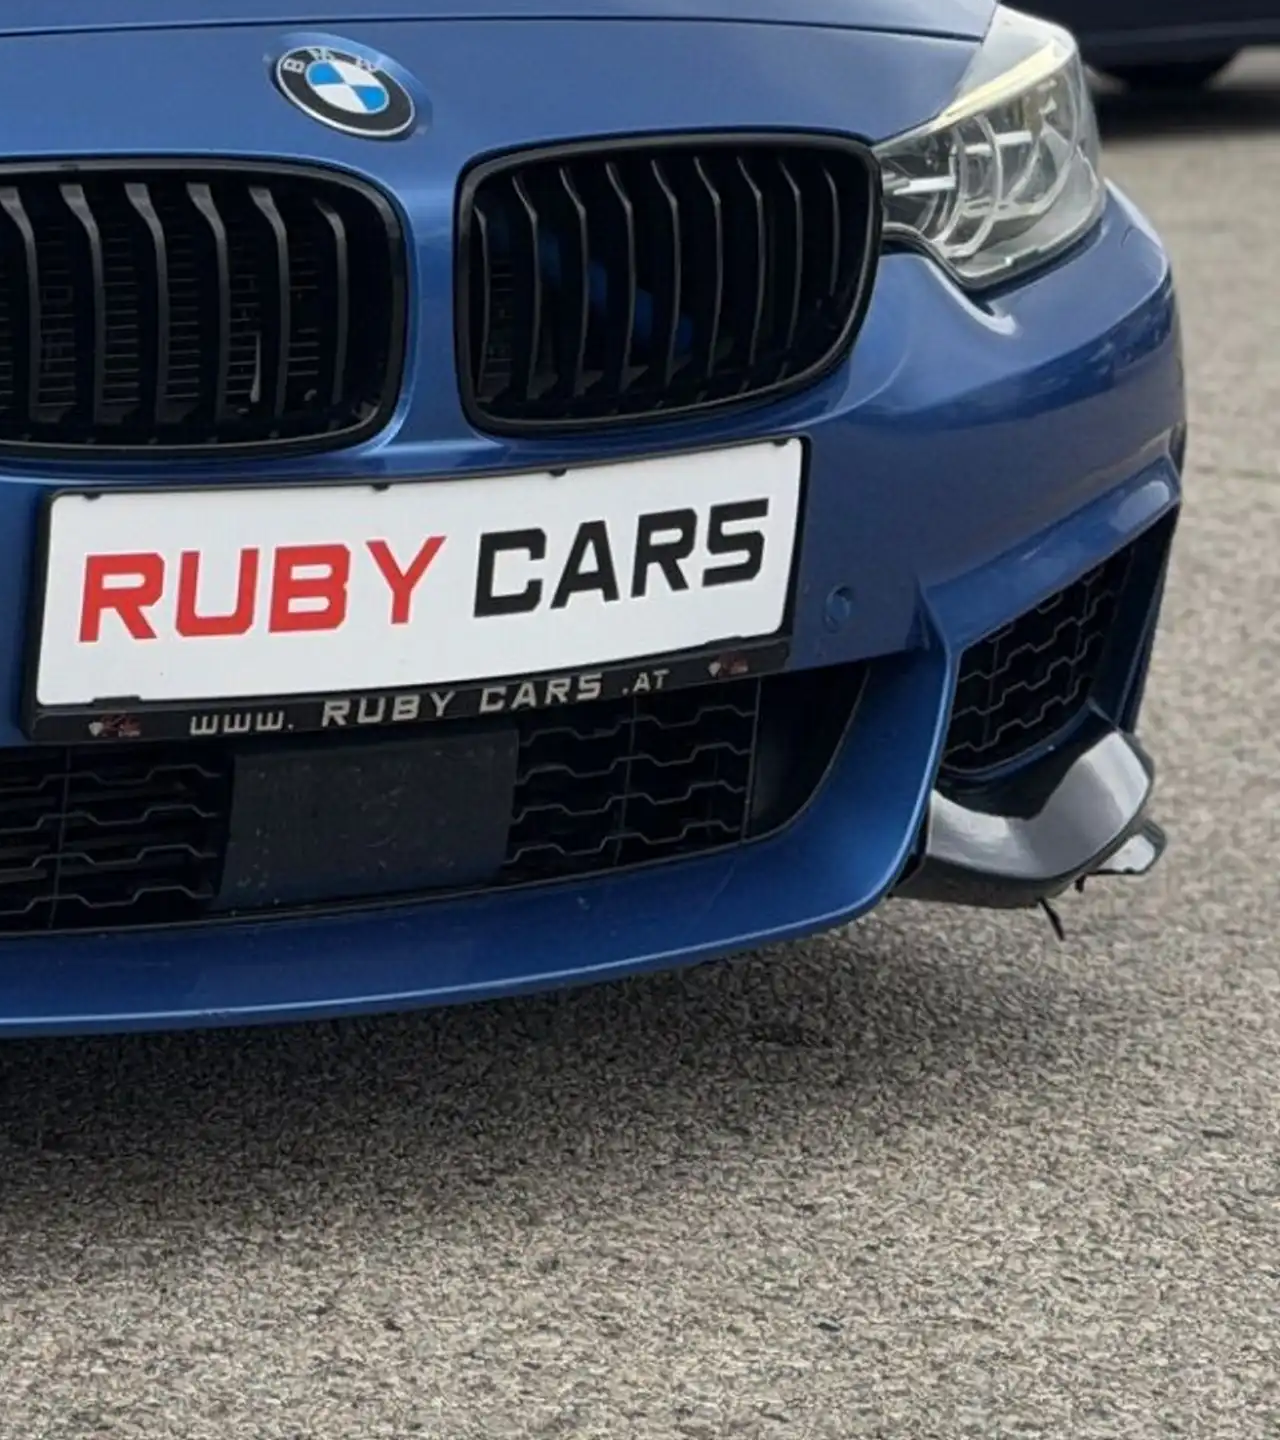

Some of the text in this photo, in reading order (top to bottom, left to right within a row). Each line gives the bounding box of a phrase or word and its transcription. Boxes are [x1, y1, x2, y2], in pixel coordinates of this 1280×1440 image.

[282, 48, 384, 75] BMW
[78, 498, 769, 644] RUBY CARS
[321, 690, 456, 728] RUBY
[479, 673, 603, 714] CARS
